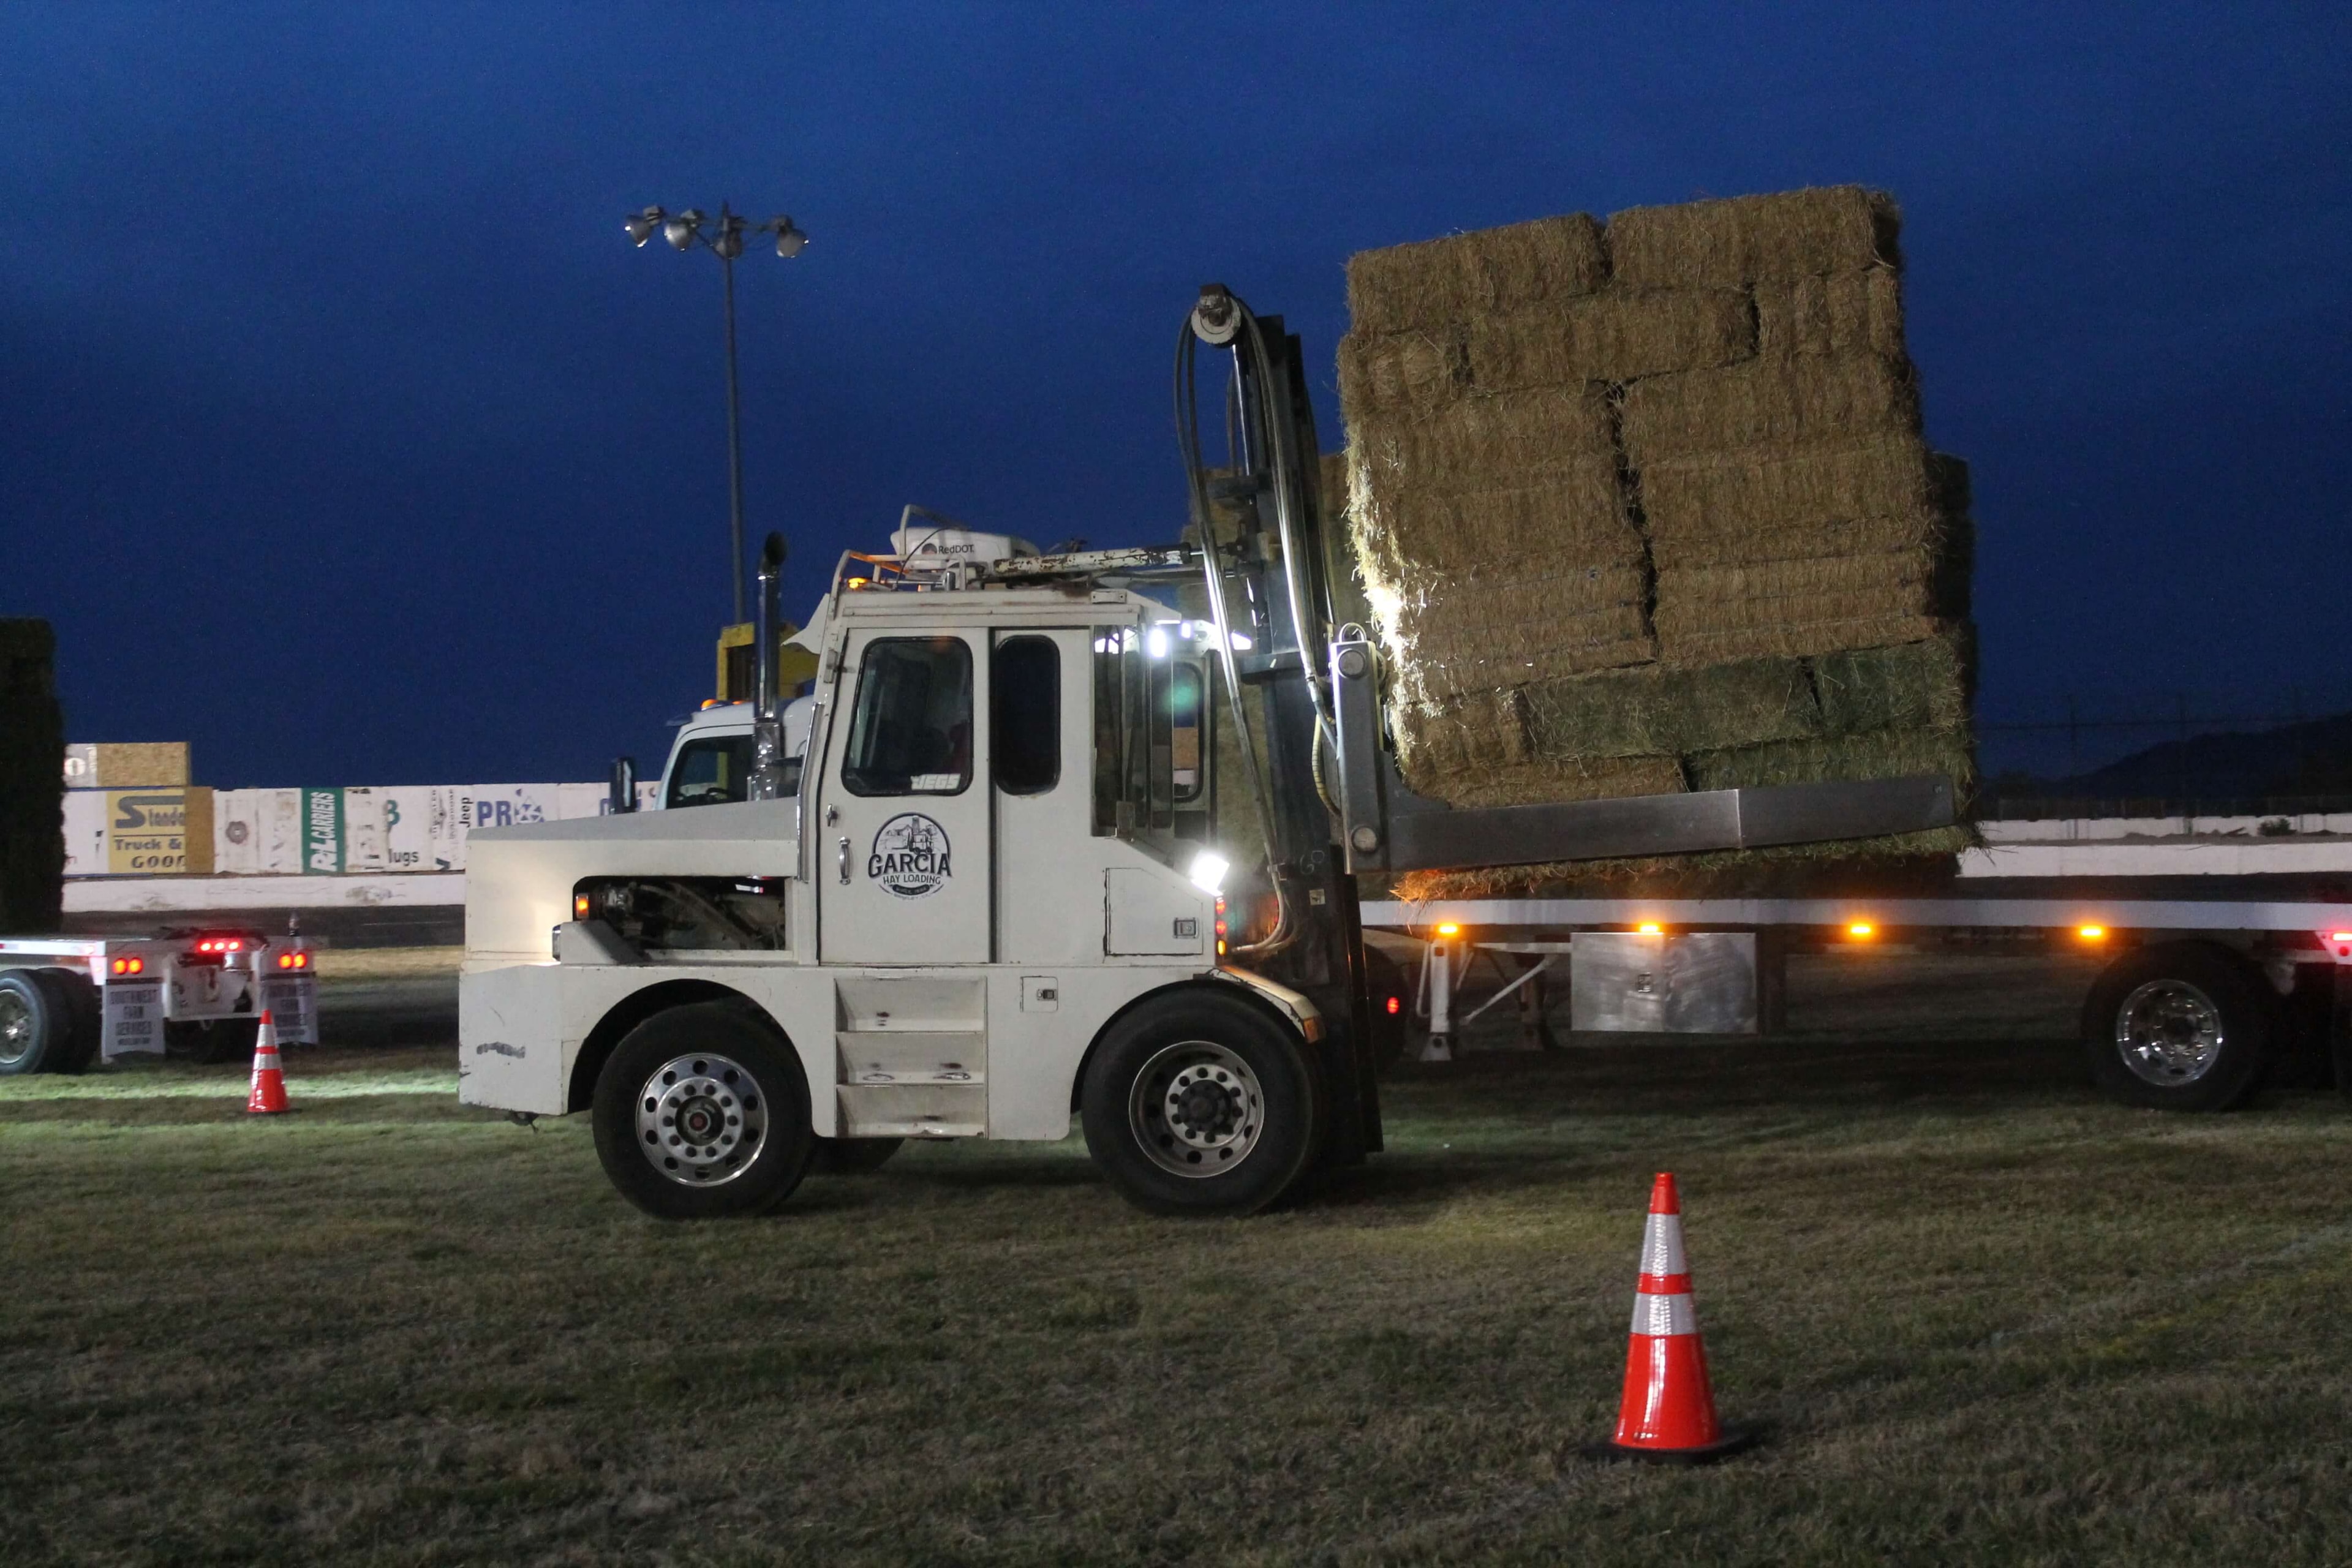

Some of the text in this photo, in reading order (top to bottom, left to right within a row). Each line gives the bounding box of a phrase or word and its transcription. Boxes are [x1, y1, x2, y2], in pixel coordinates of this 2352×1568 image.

[311, 791, 335, 840] CARRIERS
[459, 797, 474, 828] Jeep
[114, 838, 181, 850] Truck &
[868, 853, 952, 878] GARCIA
[883, 874, 941, 885] HAY LOADING
